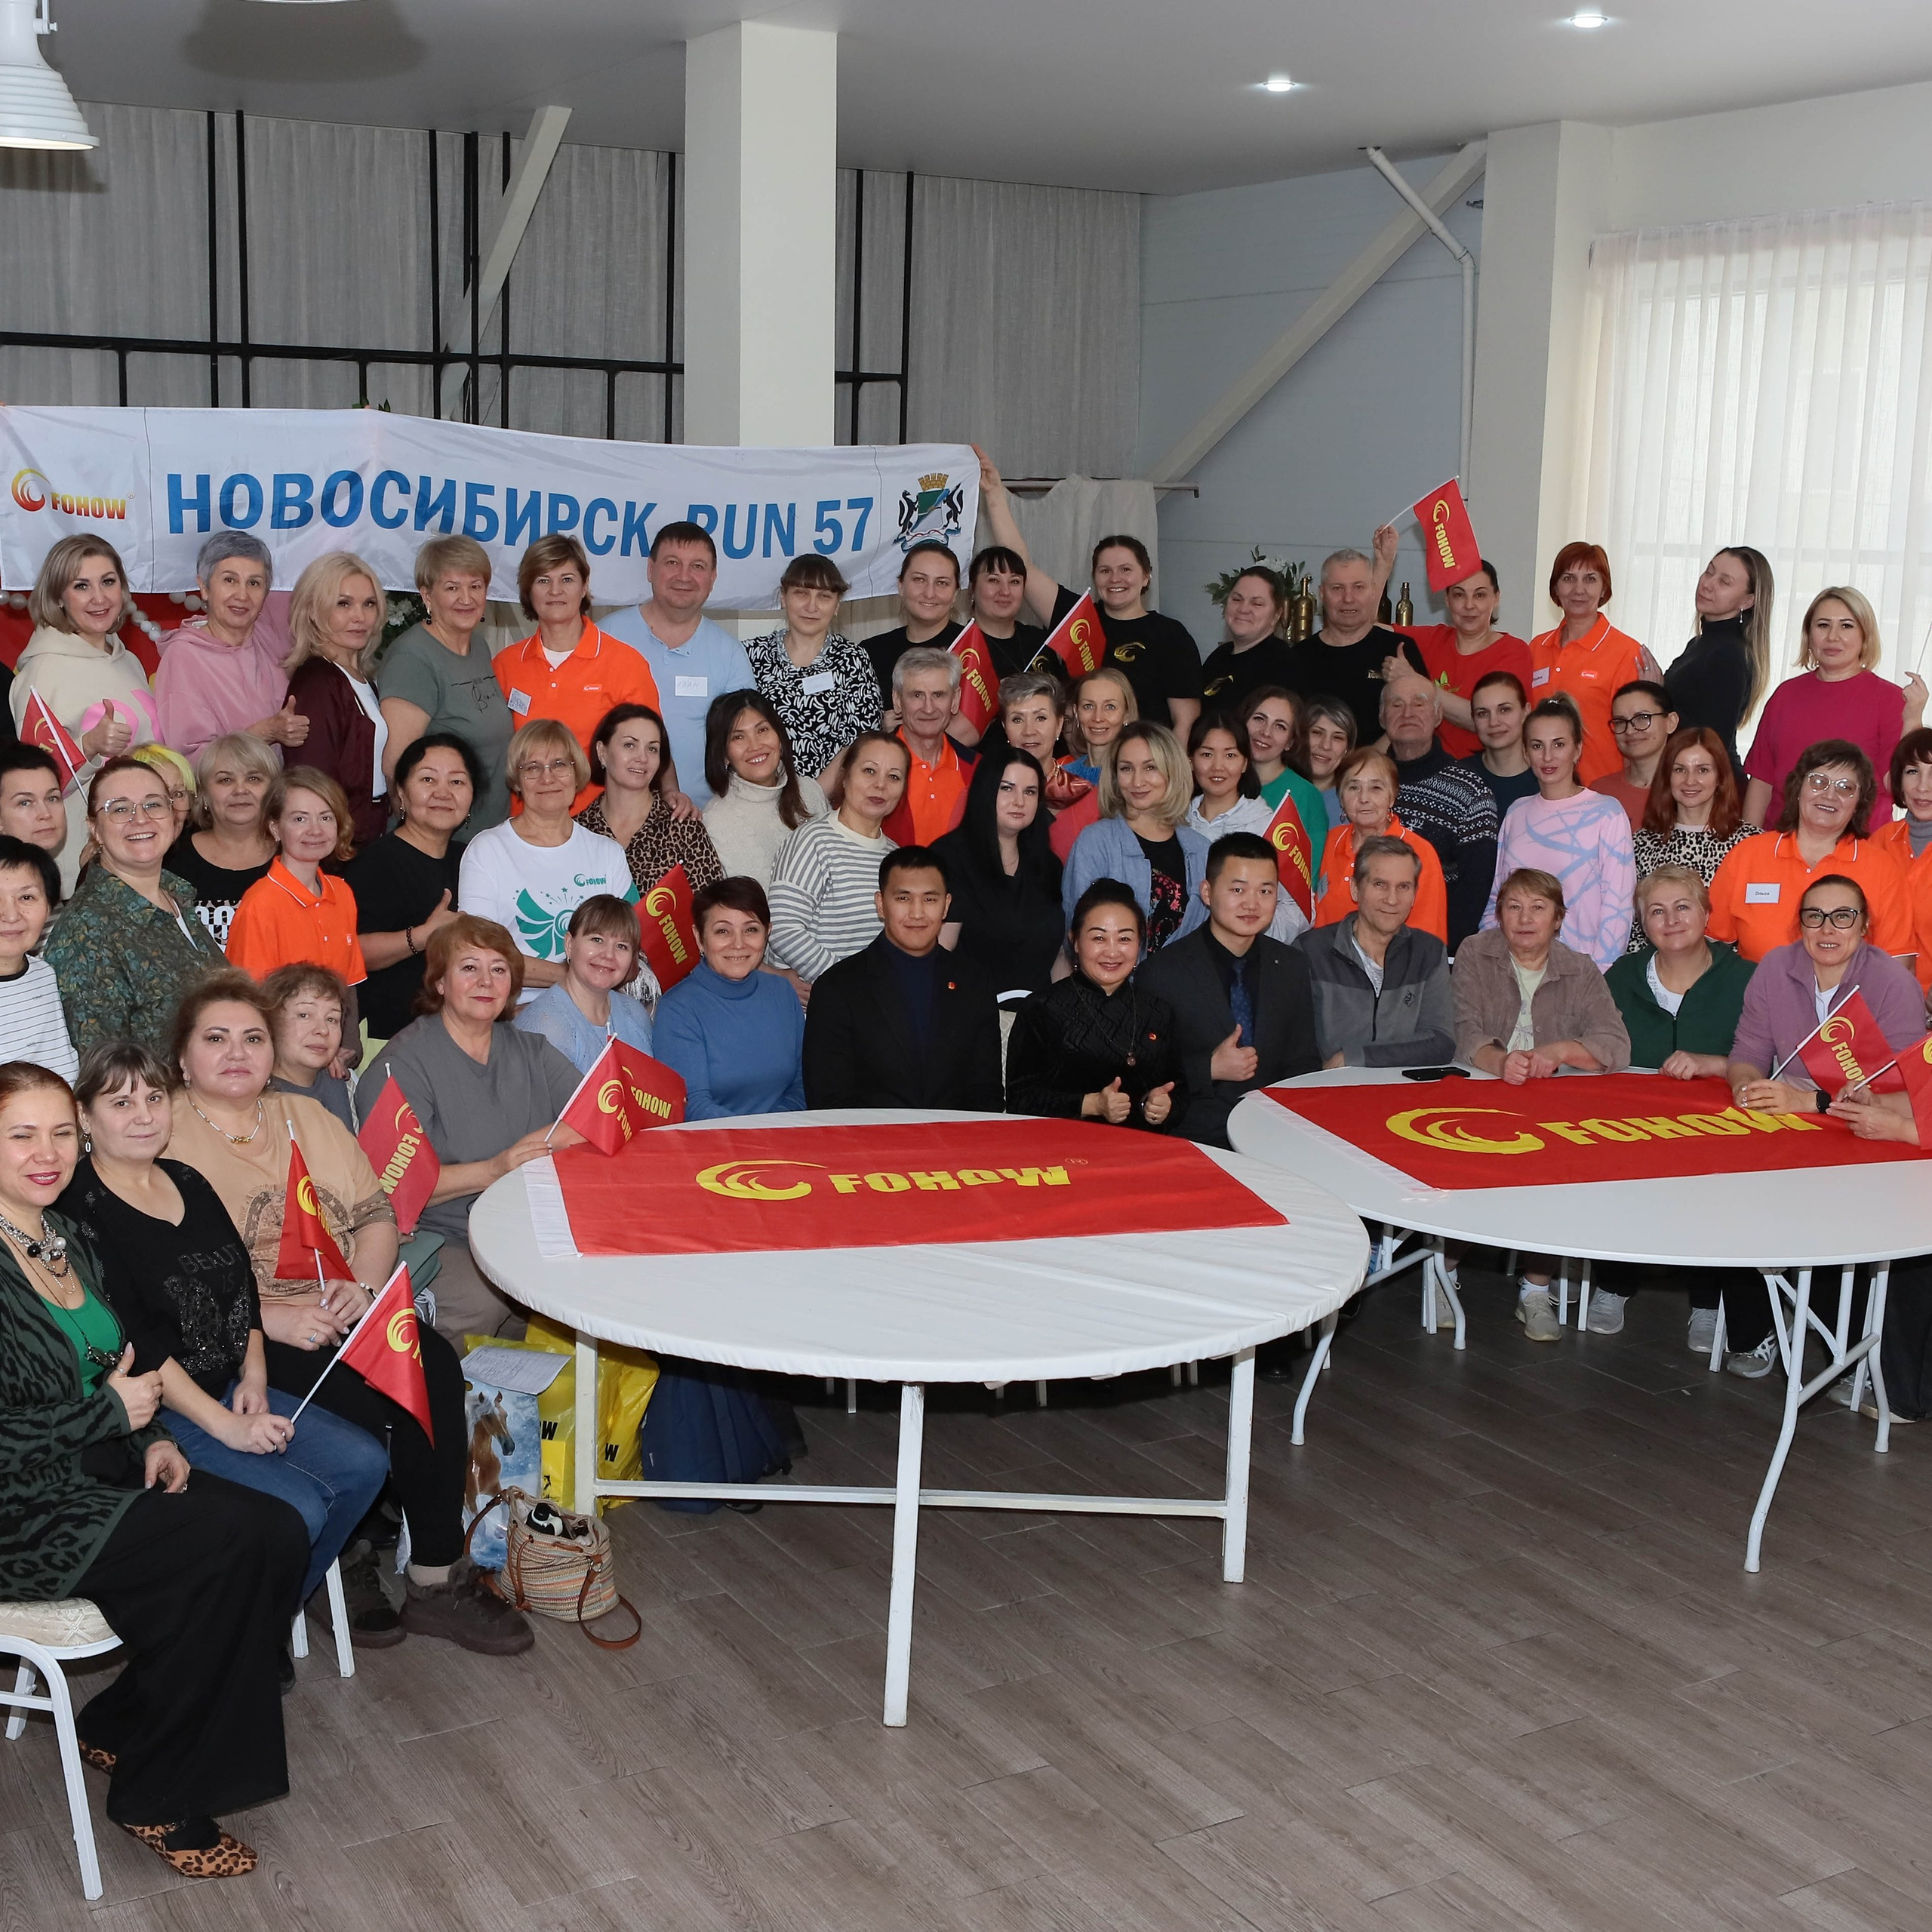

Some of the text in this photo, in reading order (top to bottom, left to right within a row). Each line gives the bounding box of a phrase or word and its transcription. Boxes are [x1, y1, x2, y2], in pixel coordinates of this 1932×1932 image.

[51, 492, 127, 520] FOHOW
[167, 469, 657, 557] НОВОСИБИРСК
[813, 497, 874, 555] 57
[1435, 523, 1456, 568] FOHOW
[966, 669, 992, 712] FOHOW
[658, 914, 688, 964] FOHOW
[379, 1133, 420, 1195] FOHOW
[827, 1165, 1072, 1194] FOHOW
